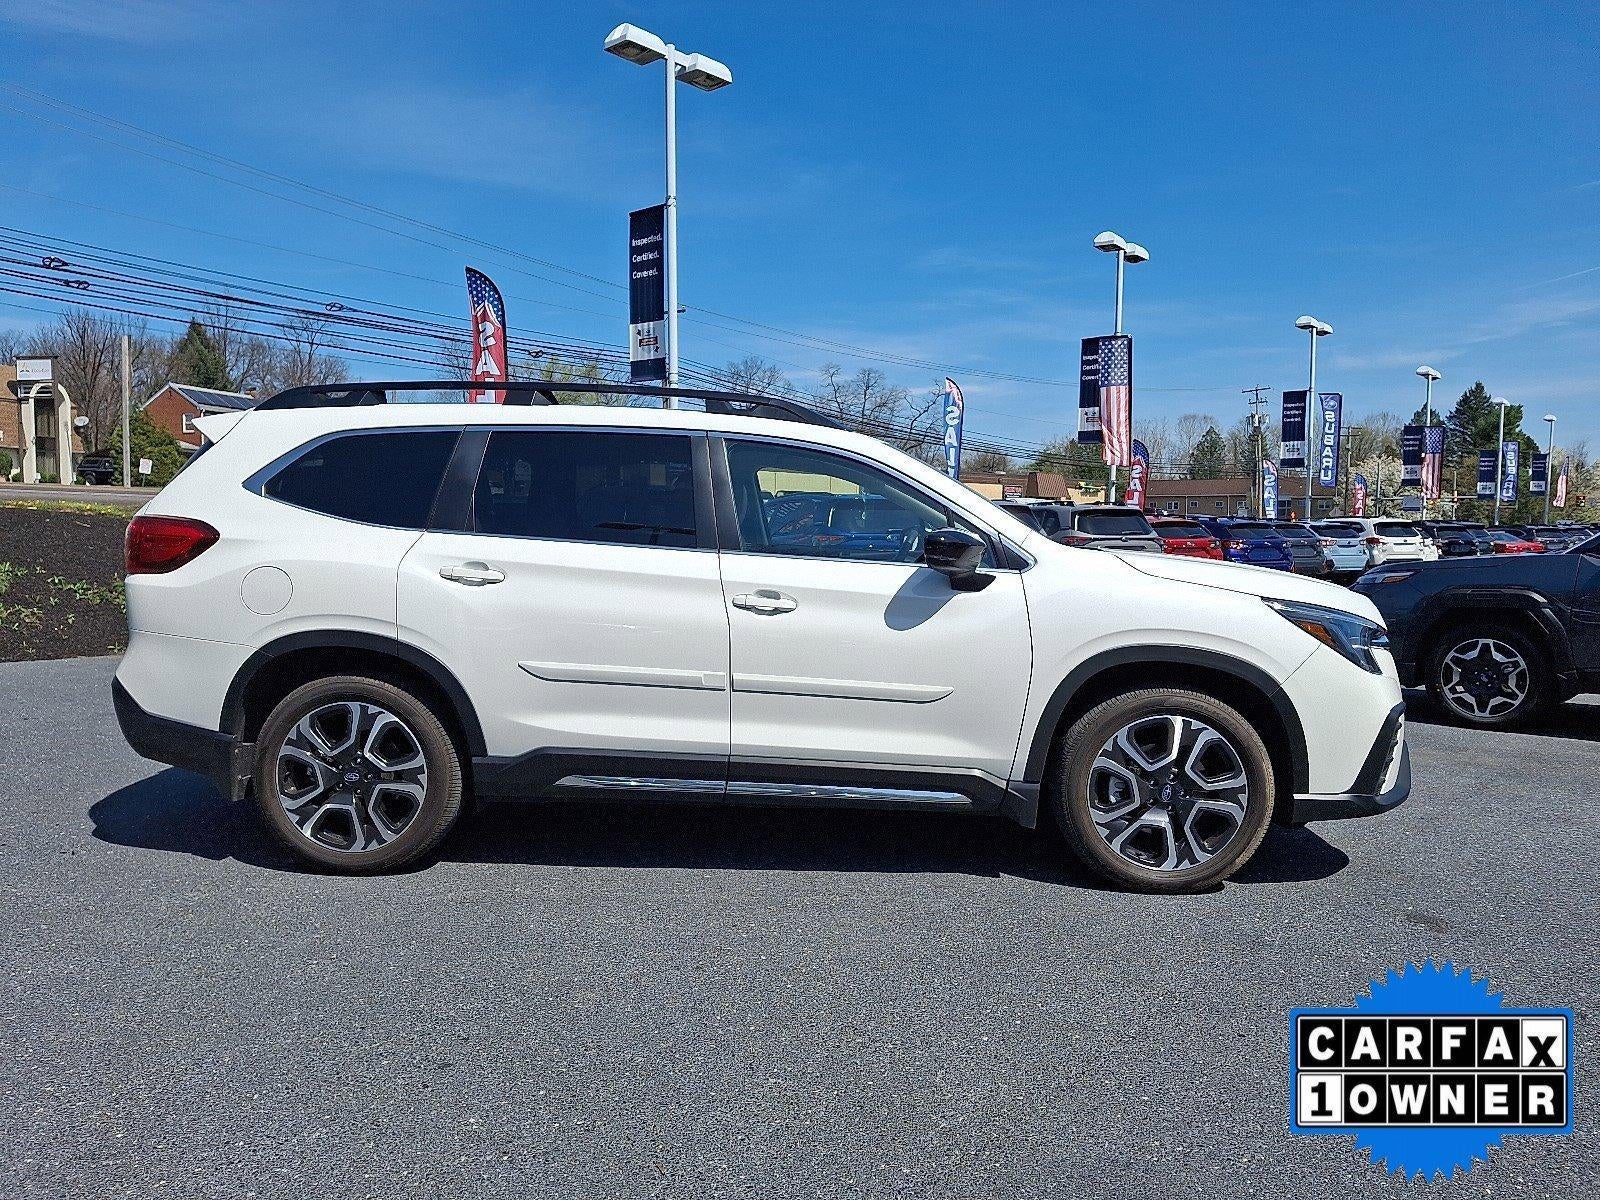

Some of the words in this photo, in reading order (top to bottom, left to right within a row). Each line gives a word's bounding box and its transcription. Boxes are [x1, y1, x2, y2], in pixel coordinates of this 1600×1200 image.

[632, 233, 662, 246] Inspected.
[632, 250, 659, 263] Certified.
[632, 267, 658, 279] Covered.
